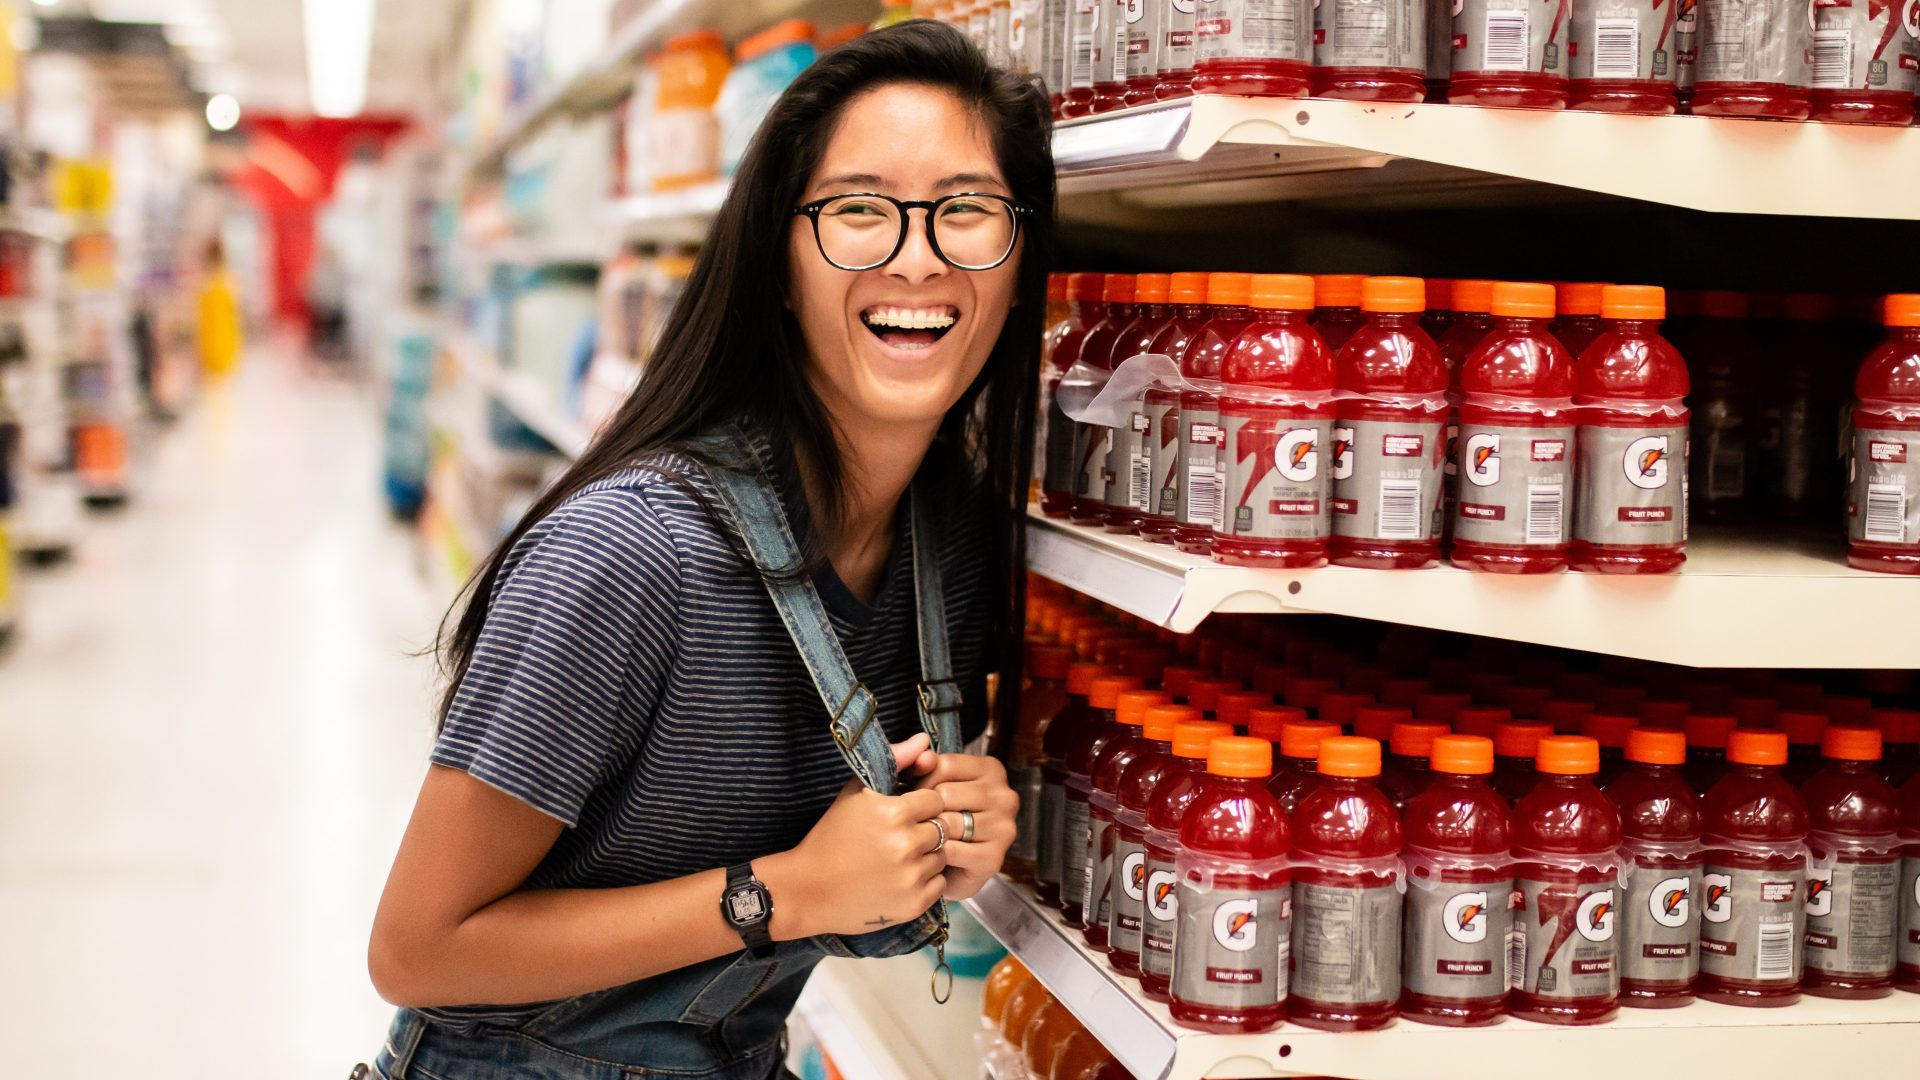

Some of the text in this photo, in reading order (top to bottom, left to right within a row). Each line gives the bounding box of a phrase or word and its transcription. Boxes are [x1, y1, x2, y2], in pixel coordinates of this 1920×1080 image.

[1872, 62, 1884, 73] 80
[1274, 428, 1319, 482] G
[1465, 433, 1501, 487] G
[1623, 435, 1668, 490] G
[1164, 490, 1173, 500] 80
[1465, 506, 1496, 516] FRUIT PUNCH
[1147, 870, 1178, 922] G
[1702, 873, 1732, 923] G
[1648, 876, 1690, 928] G
[1442, 891, 1488, 944] G
[1576, 889, 1614, 942] G
[1122, 918, 1135, 927] FRUIT
[1212, 899, 1258, 952] G
[1148, 939, 1159, 948] FRUIT
[1809, 936, 1828, 944] PUNCH
[1709, 943, 1727, 951] PUNCH
[1464, 964, 1484, 972] PUNCH
[1216, 971, 1253, 981] FRUIT PUNCH
[1542, 969, 1553, 979] 80
